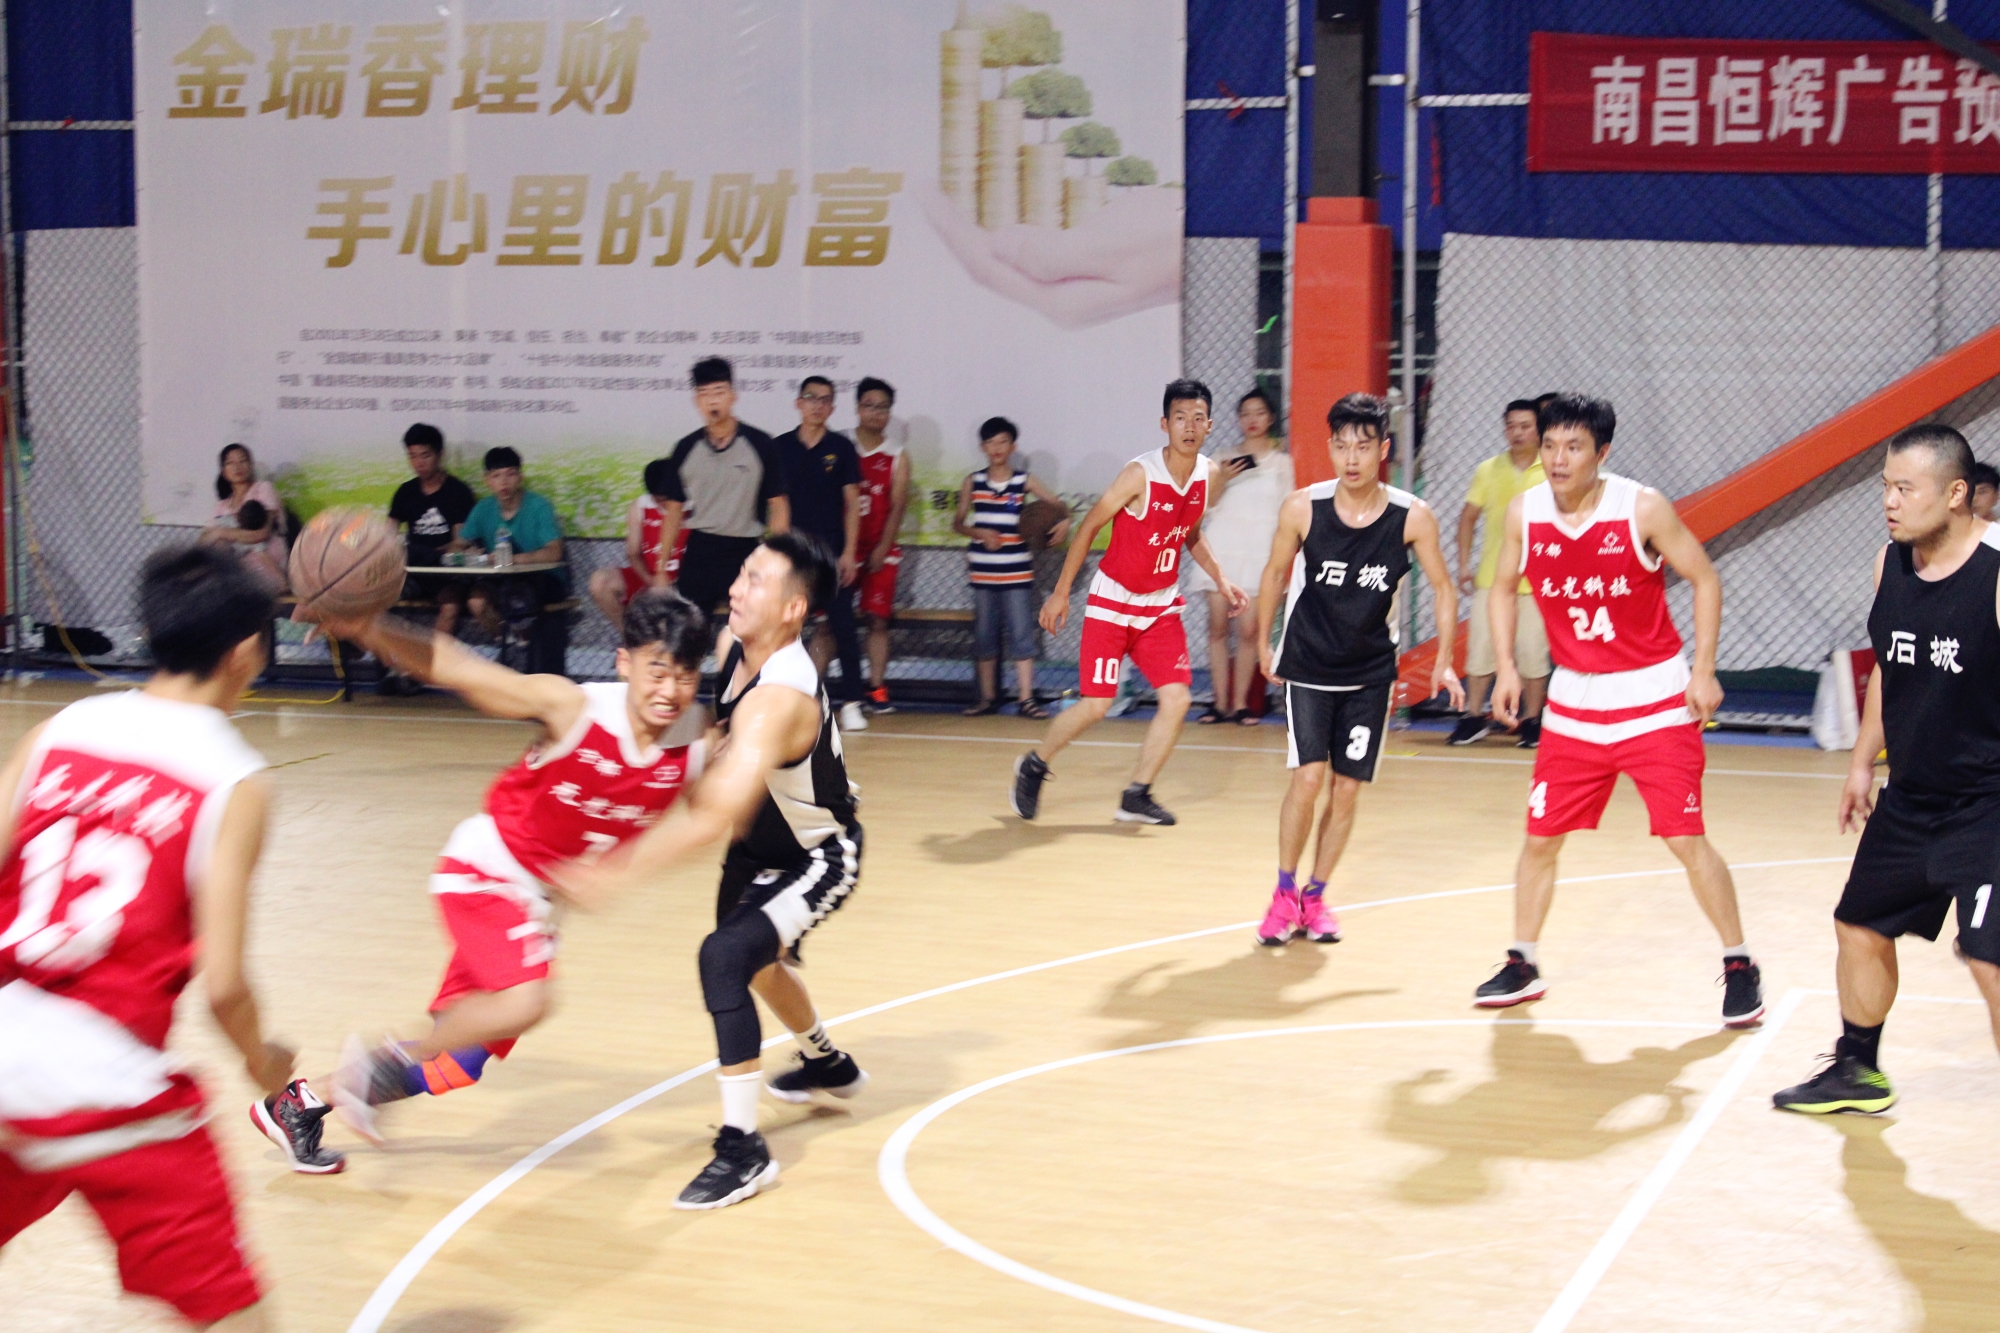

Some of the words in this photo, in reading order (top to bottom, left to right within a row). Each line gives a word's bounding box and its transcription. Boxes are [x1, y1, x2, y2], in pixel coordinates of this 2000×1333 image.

[166, 13, 651, 120] 金瑞香理财
[304, 166, 905, 269] 手心里的财富
[1153, 548, 1176, 575] 10
[1315, 560, 1390, 592] 石城
[1567, 606, 1617, 643] 24
[1092, 657, 1119, 685] 10
[1886, 631, 1964, 674] 石城
[1345, 724, 1372, 761] 3
[1527, 778, 1548, 819] 4
[0, 815, 153, 973] 13
